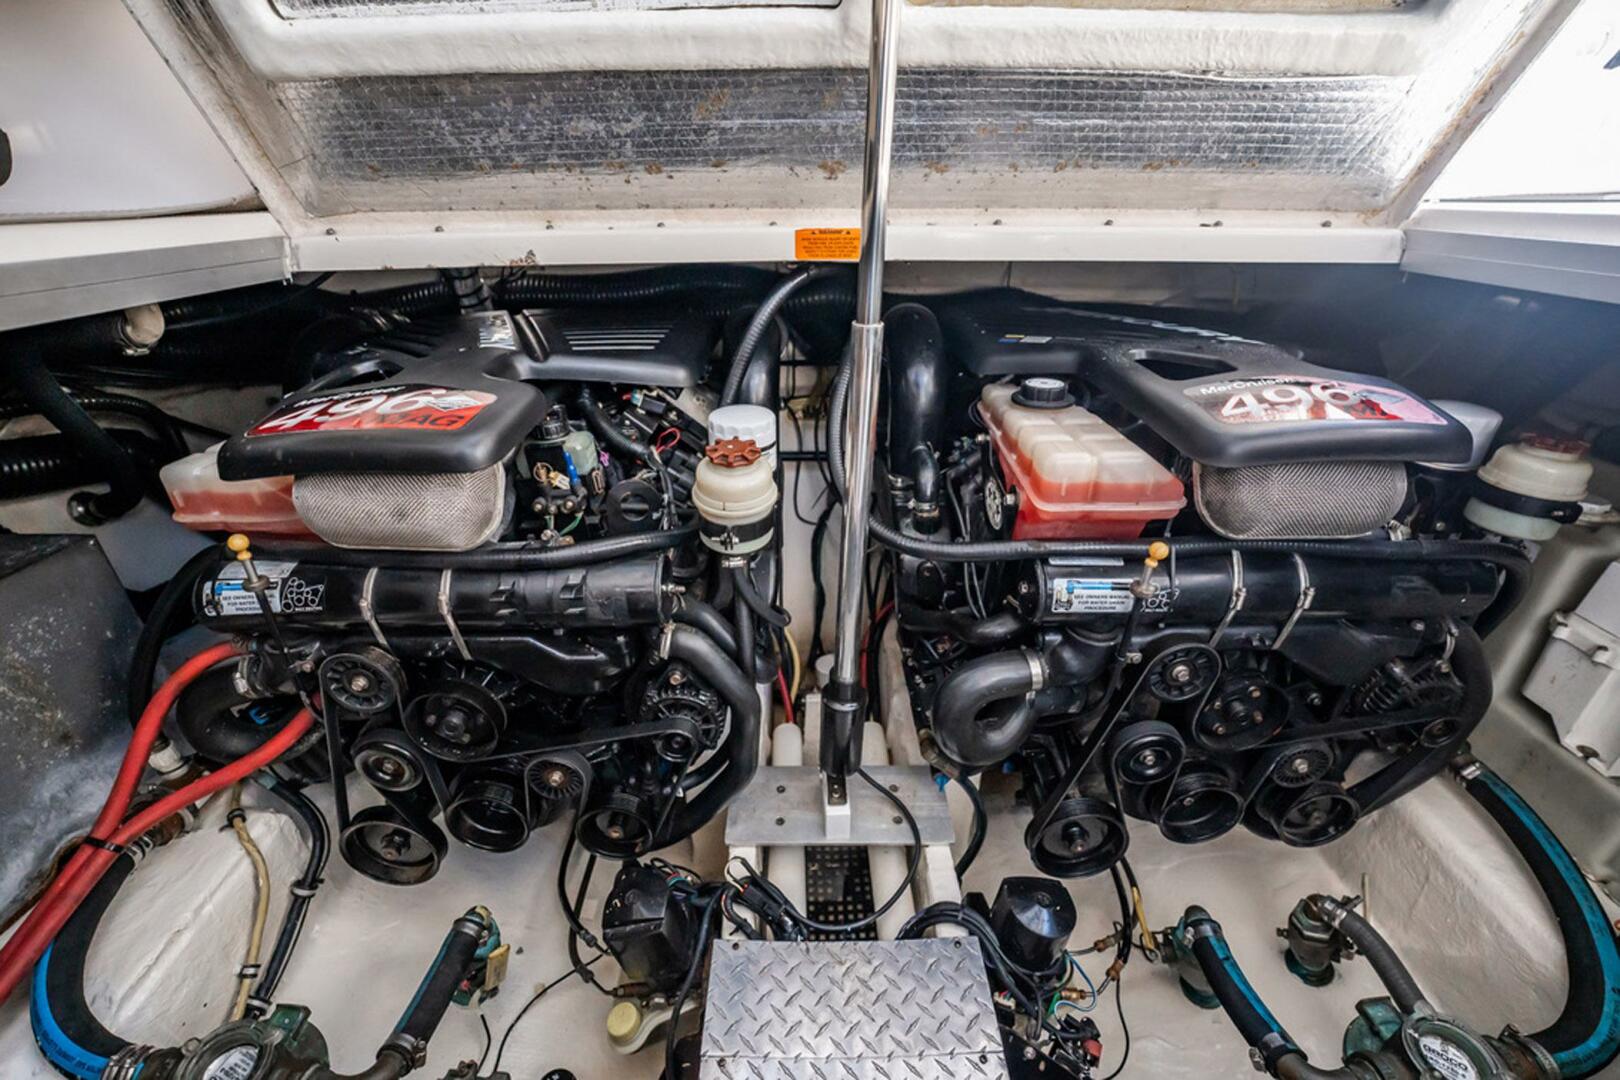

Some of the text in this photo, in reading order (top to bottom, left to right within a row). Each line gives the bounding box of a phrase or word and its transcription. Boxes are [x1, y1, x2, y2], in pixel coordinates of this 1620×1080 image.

[1200, 376, 1294, 396] MerCruiser
[1220, 380, 1356, 420] 496
[256, 388, 448, 430] 496
